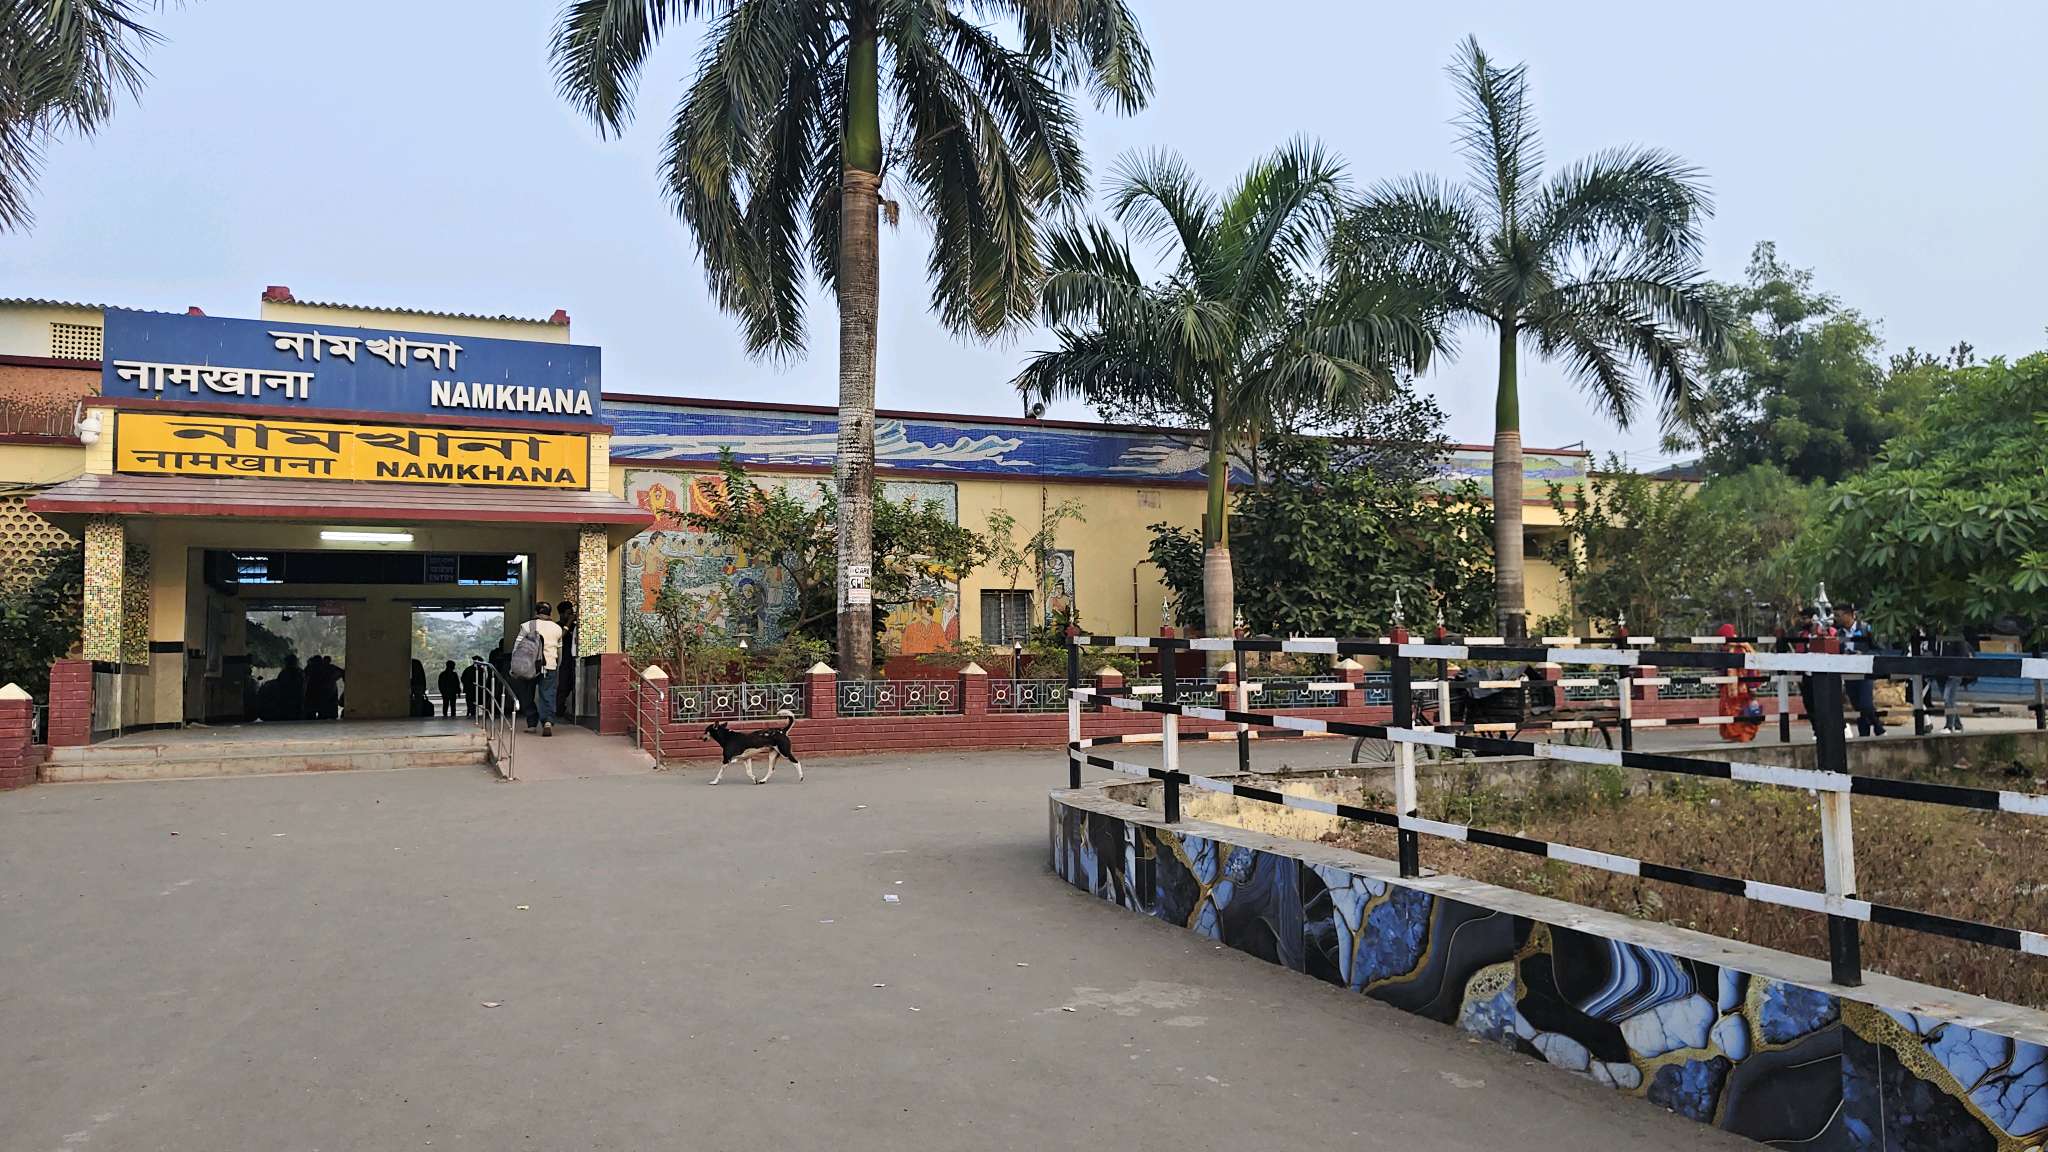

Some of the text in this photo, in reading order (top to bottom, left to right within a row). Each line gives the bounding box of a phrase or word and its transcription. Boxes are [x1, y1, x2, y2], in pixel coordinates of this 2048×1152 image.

[113, 360, 315, 399] नामखाना
[431, 381, 593, 416] NAMKHANA
[131, 451, 338, 475] नामखाना
[376, 462, 577, 484] NAMKHANA
